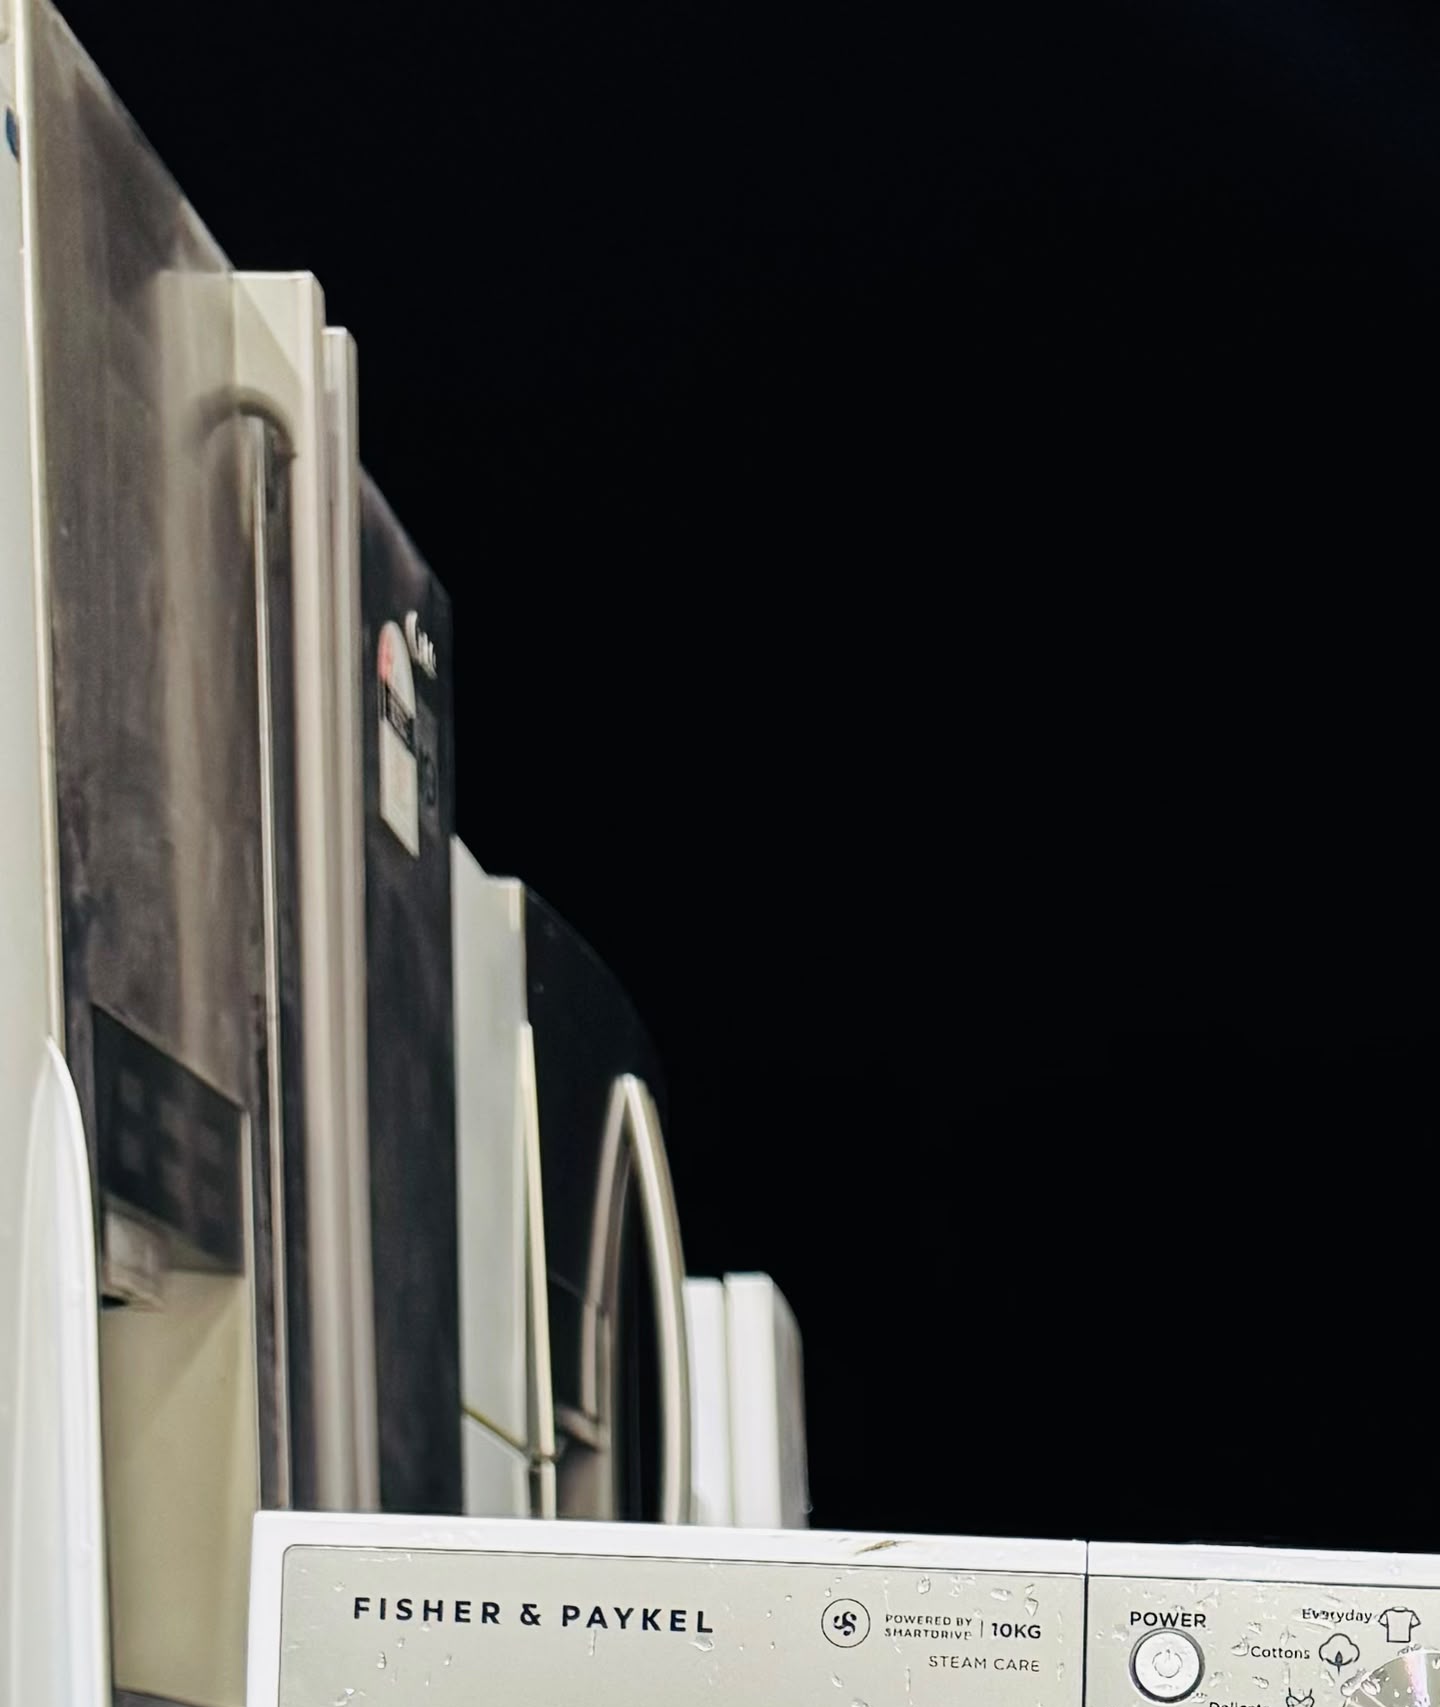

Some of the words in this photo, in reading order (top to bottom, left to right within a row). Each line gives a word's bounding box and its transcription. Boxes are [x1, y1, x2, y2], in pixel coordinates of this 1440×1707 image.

[353, 1596, 501, 1626] FISHER
[520, 1602, 542, 1627] &
[561, 1605, 715, 1634] PAYKEL
[885, 1614, 951, 1626] POWERED
[956, 1617, 972, 1626] BY
[1129, 1611, 1207, 1627] POWER
[1302, 1608, 1373, 1625] Everyday
[991, 1622, 1041, 1639] 10KG
[1250, 1646, 1311, 1661] Cottons
[929, 1655, 987, 1669] STEAM
[994, 1658, 1040, 1672] CARE
